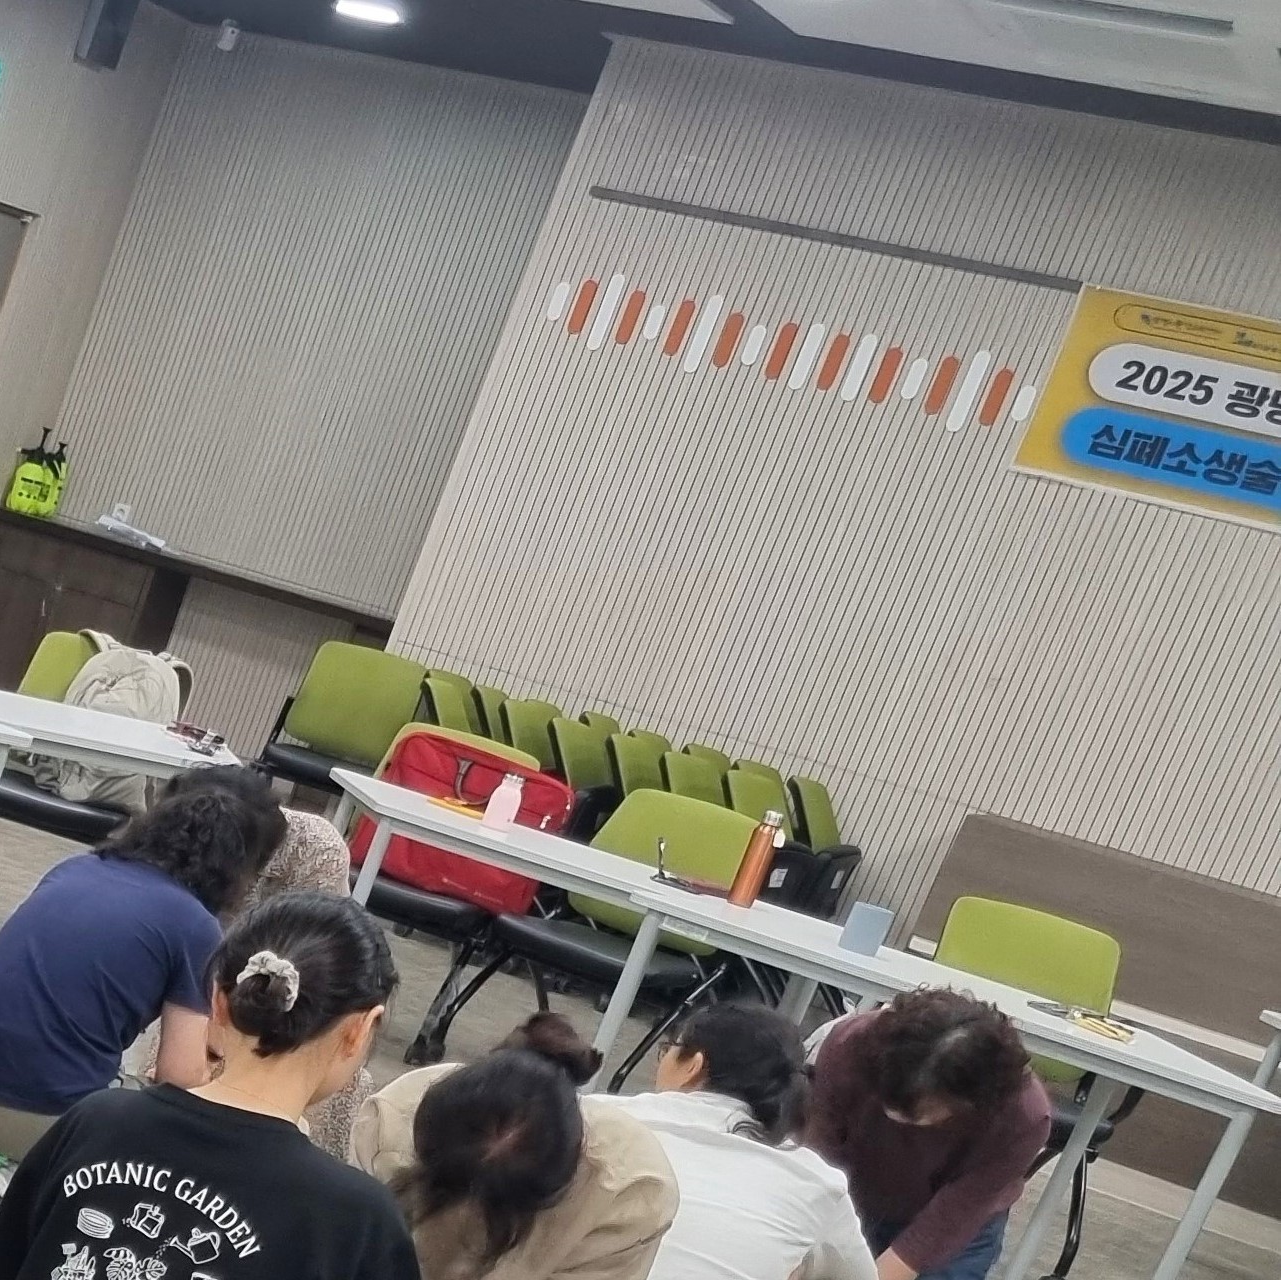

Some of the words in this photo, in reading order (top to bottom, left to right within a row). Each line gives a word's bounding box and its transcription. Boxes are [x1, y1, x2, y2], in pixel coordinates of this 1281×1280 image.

[1115, 360, 1219, 405] 2025
[1087, 424, 1281, 496] 심폐소생술
[63, 1162, 171, 1198] BOTANIC
[174, 1178, 261, 1259] GARDEN
